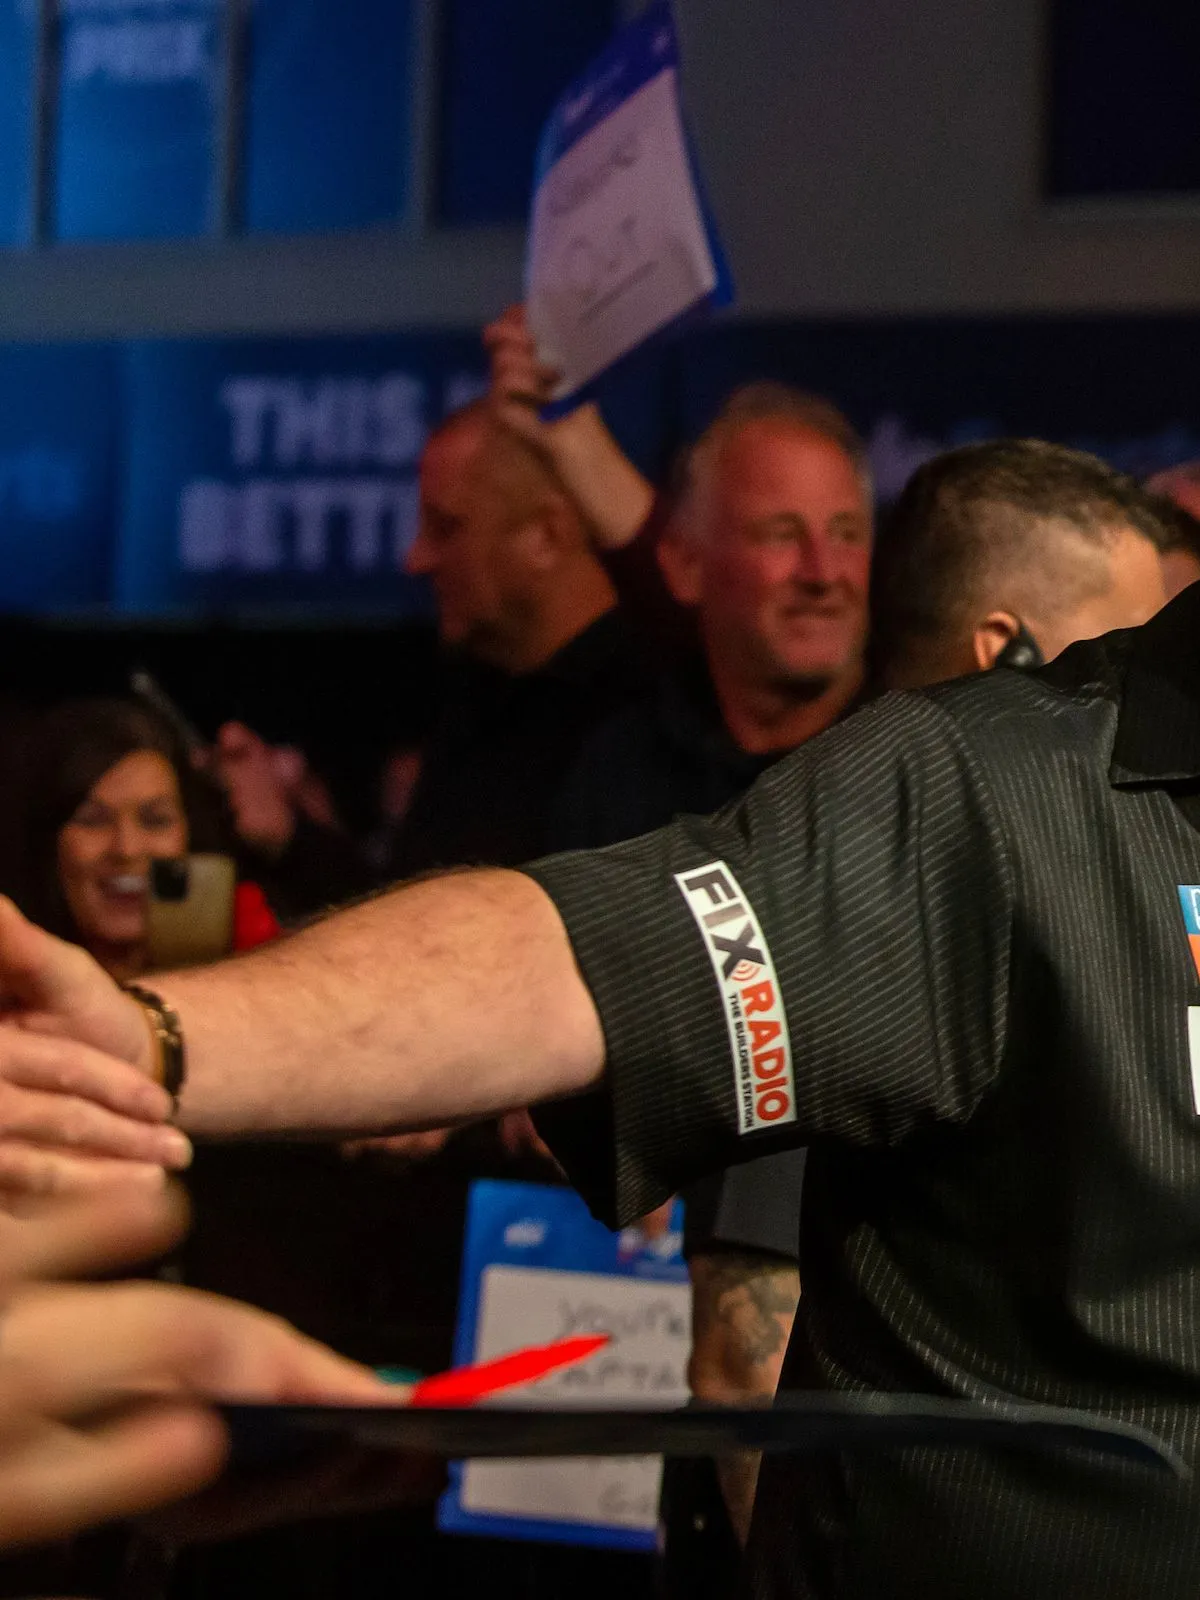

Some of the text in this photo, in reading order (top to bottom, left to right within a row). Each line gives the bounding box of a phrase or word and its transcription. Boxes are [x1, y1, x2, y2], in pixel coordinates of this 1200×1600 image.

[683, 869, 790, 1121] FIX RADIO
[728, 992, 754, 1128] THE BUILDERS STATION
